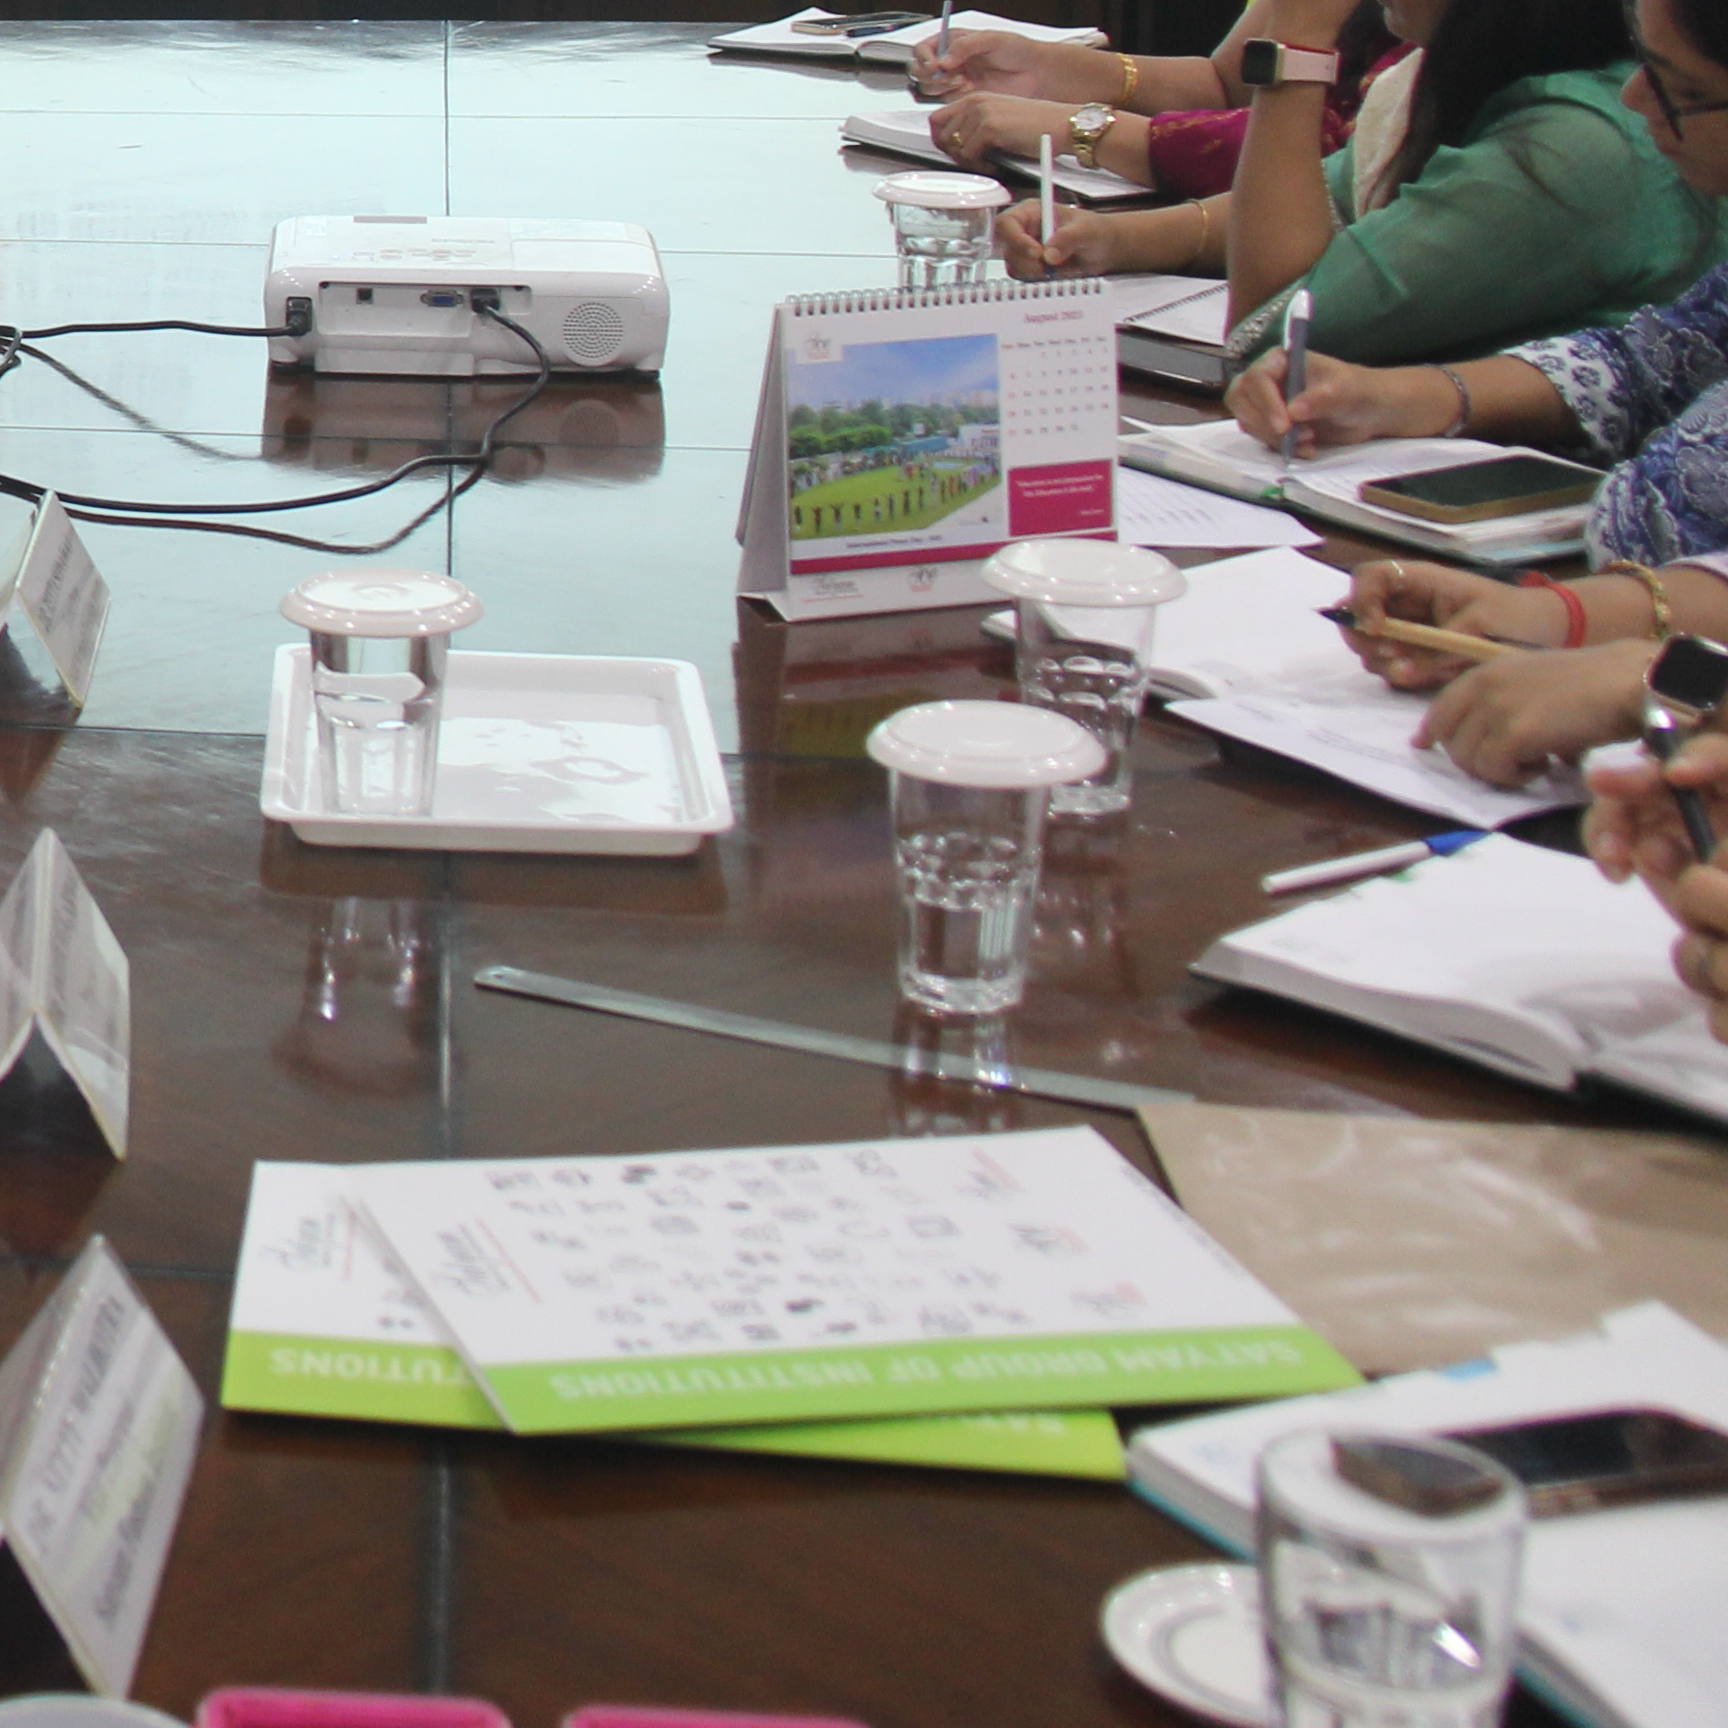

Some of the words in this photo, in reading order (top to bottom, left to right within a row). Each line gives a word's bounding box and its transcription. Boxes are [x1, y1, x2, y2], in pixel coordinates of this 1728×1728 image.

[886, 1357, 942, 1382] OF
[951, 1350, 1108, 1379] GROUP
[1107, 1340, 1303, 1370] SATYAM
[549, 1358, 875, 1402] INSTITUTIONS
